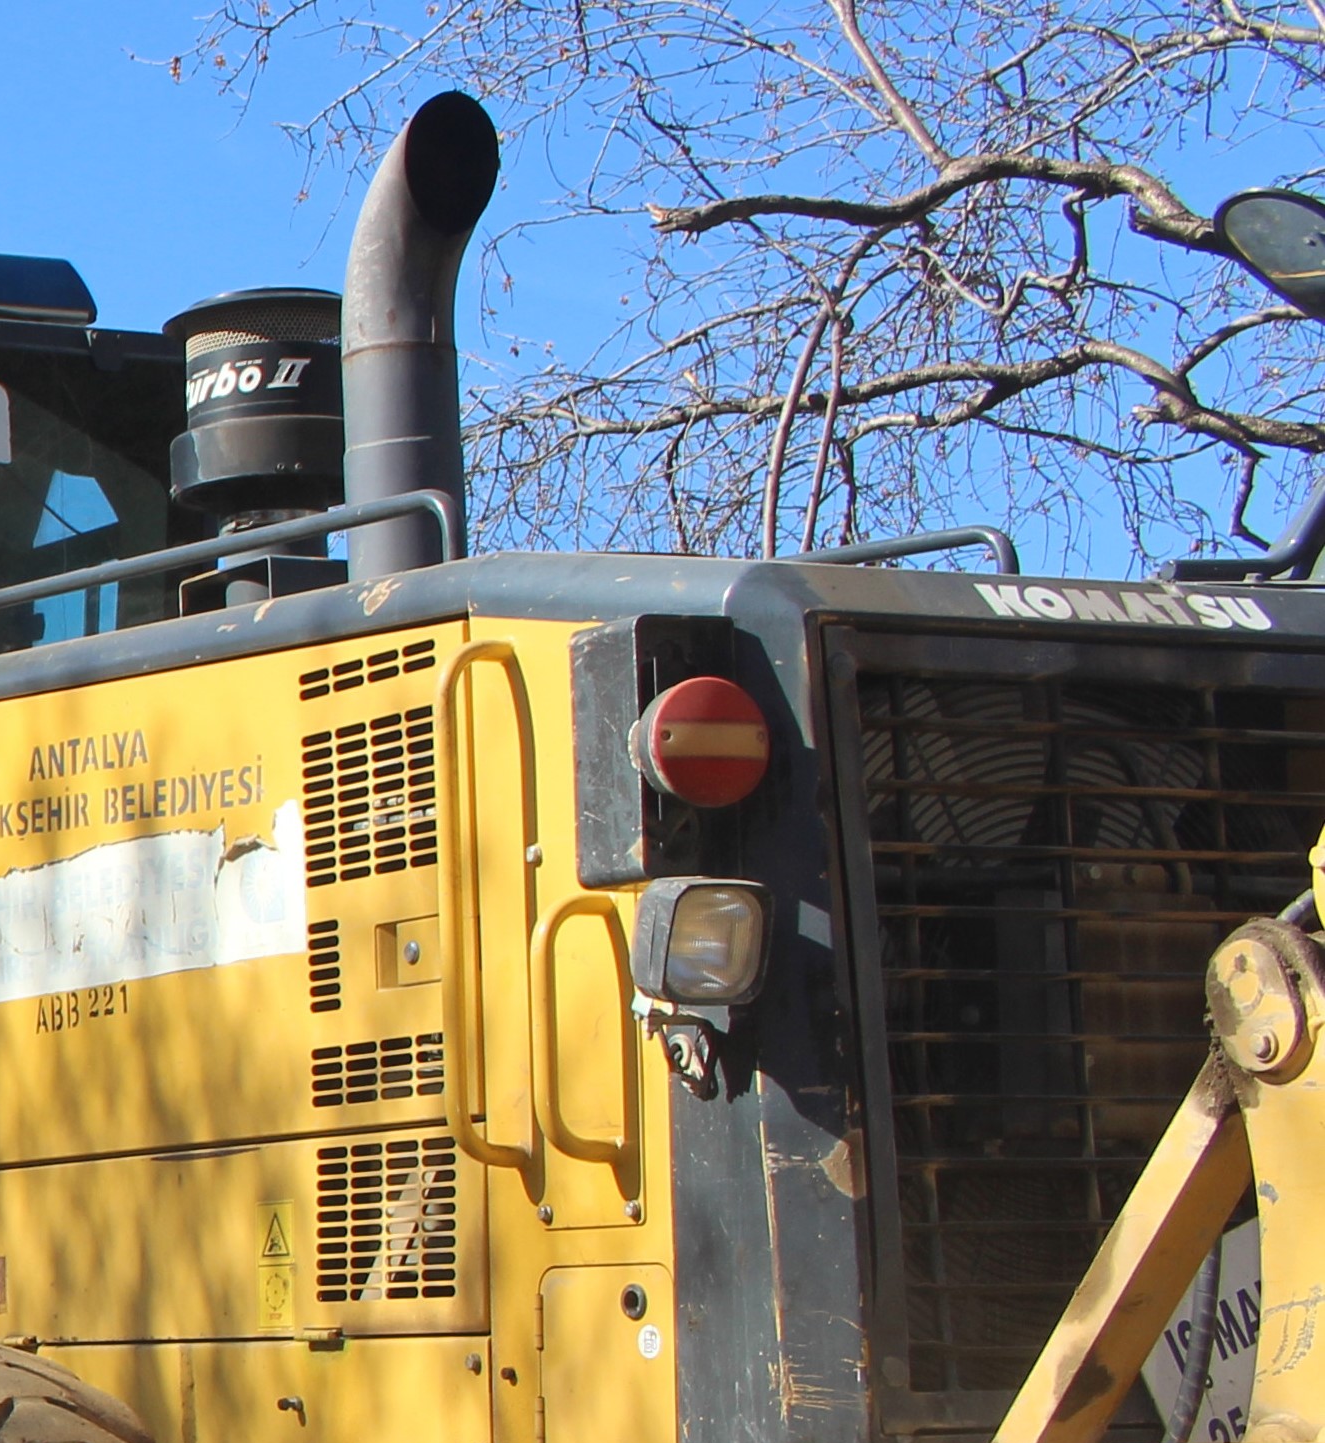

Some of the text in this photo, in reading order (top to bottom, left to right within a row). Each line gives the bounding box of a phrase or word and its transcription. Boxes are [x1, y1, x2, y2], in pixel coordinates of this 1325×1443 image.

[973, 583, 1273, 631] KOMATSU
[28, 729, 149, 782] ANTALYA
[103, 755, 263, 825] BELEDİYESİ
[36, 984, 128, 1034] ABB 221
[1214, 1280, 1262, 1361] MA
